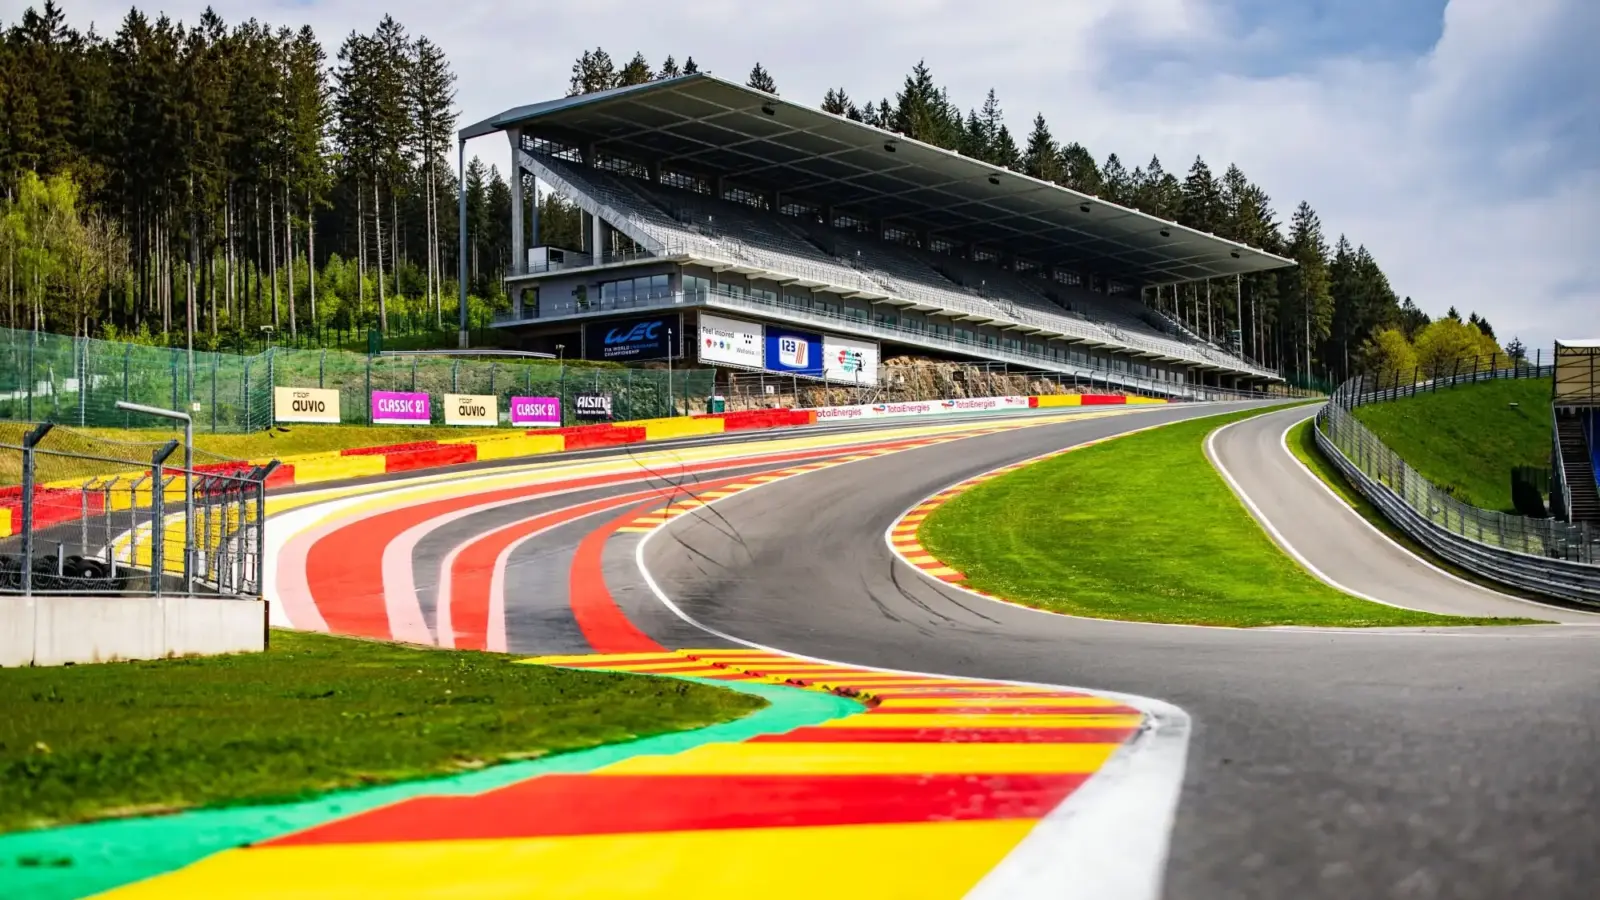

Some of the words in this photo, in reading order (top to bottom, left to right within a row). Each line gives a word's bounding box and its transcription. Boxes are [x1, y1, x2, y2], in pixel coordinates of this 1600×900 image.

[605, 321, 662, 345] WEC
[702, 326, 714, 335] Feel
[782, 340, 796, 353] 123
[292, 400, 325, 412] auvio
[378, 399, 414, 413] CLASSIC
[415, 400, 425, 413] 21
[577, 396, 606, 408] AISIN
[956, 400, 996, 409] TotalEnergies
[459, 405, 486, 416] auvio
[516, 403, 547, 416] CLASSIC
[547, 404, 556, 416] 21
[816, 408, 862, 418] otalEnergies
[887, 404, 931, 413] TotalEnergies
